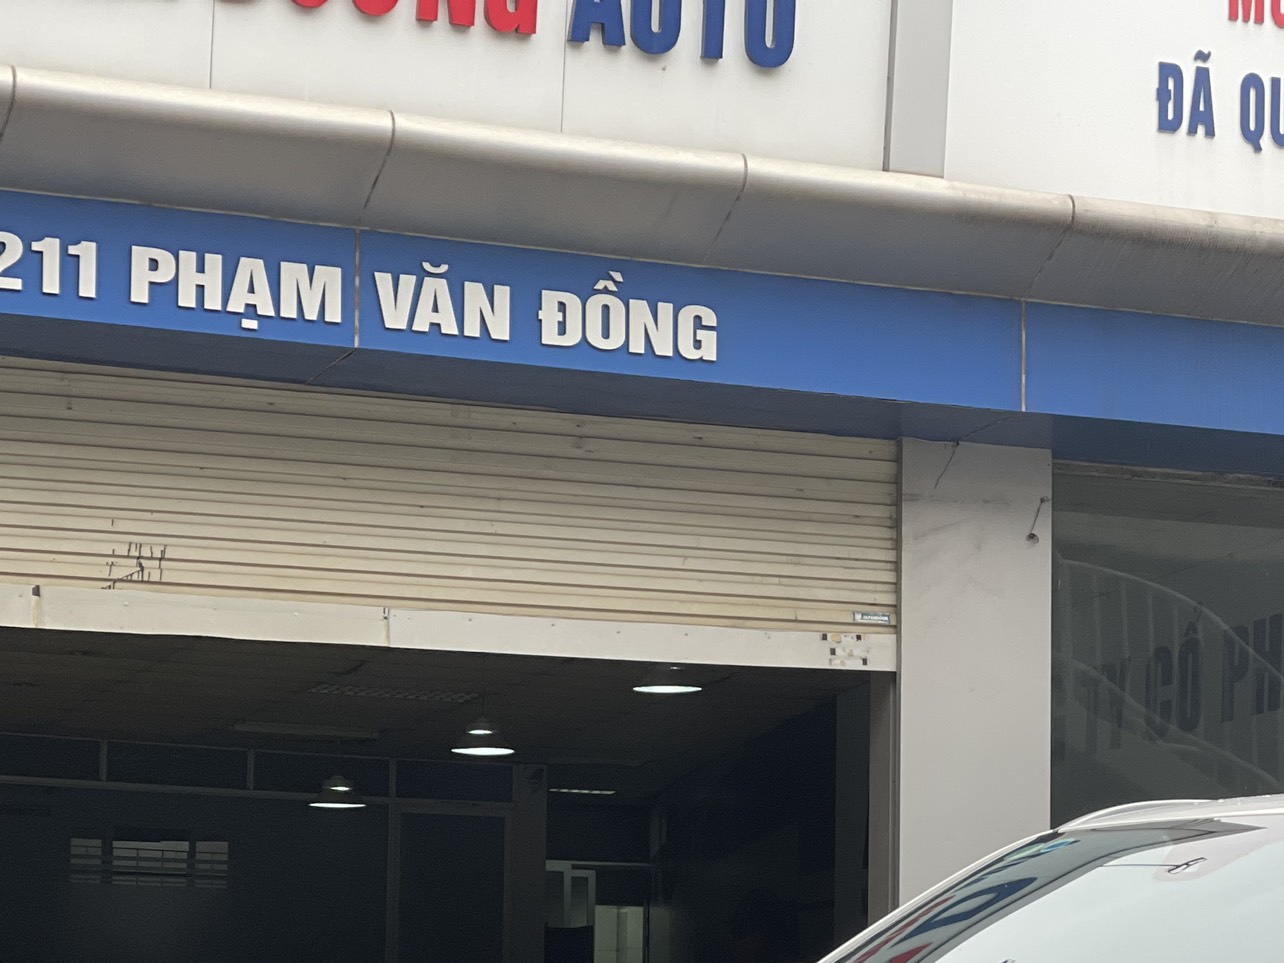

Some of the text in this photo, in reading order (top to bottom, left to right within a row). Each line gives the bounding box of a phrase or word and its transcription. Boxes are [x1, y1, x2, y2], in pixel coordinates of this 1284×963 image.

[1156, 50, 1216, 138] ĐÃ
[0, 231, 719, 362] 211 PHẠM VĂN ĐỒNG
